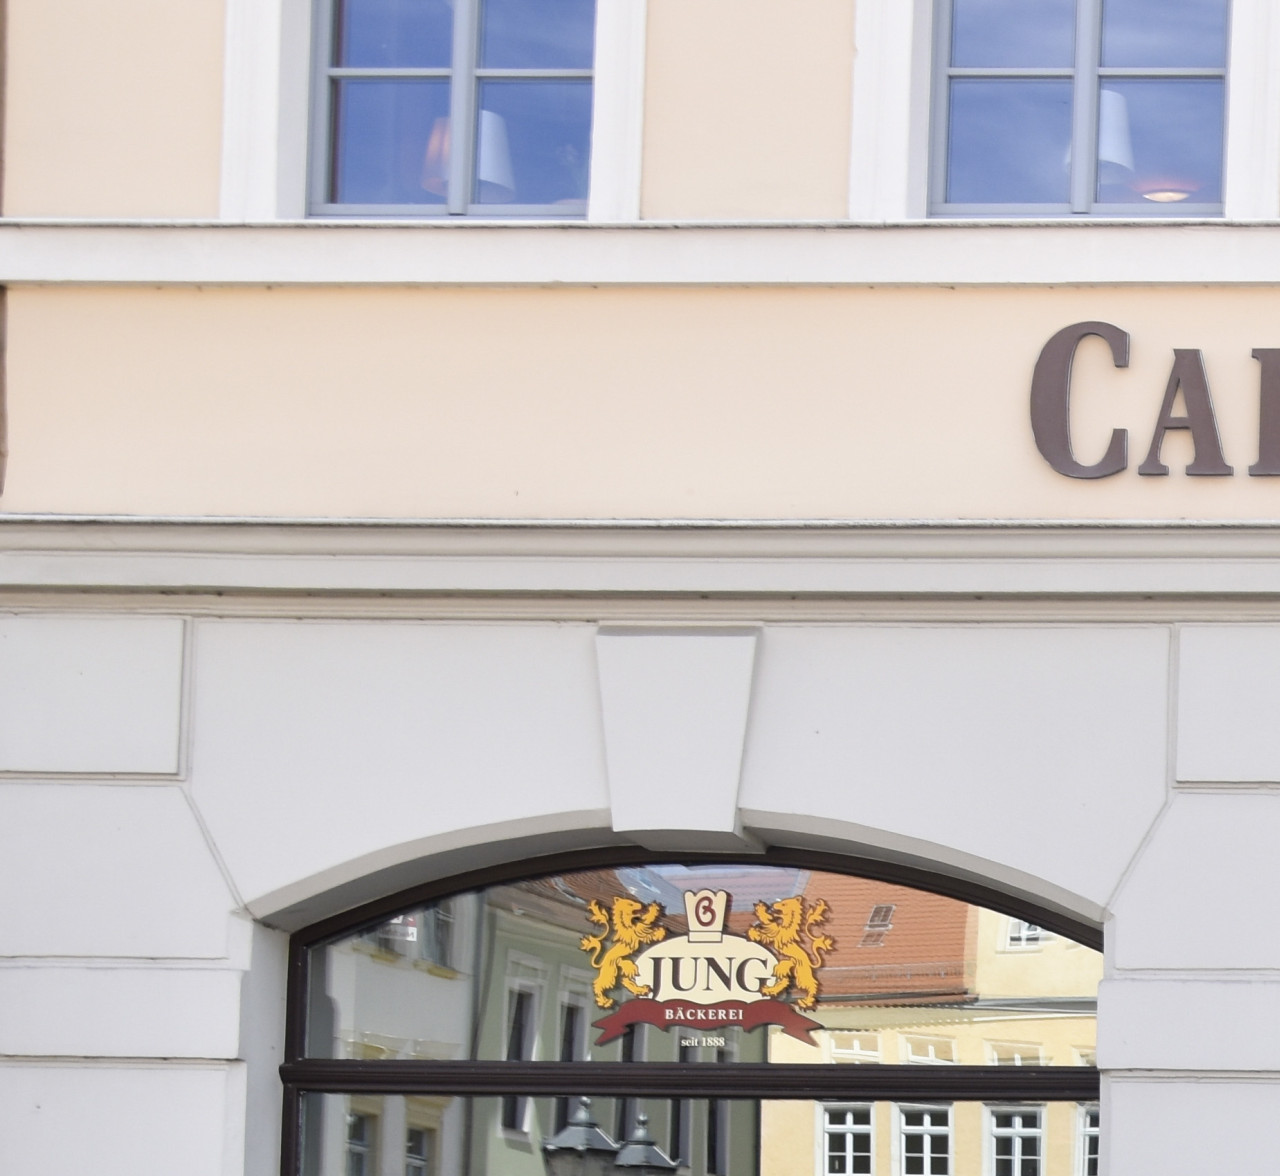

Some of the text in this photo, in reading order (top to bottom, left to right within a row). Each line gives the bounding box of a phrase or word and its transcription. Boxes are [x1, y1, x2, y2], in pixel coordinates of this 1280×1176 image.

[648, 956, 770, 998] JUNG
[664, 1006, 744, 1020] BÄCKEREI
[680, 1036, 725, 1047] seit 1888
